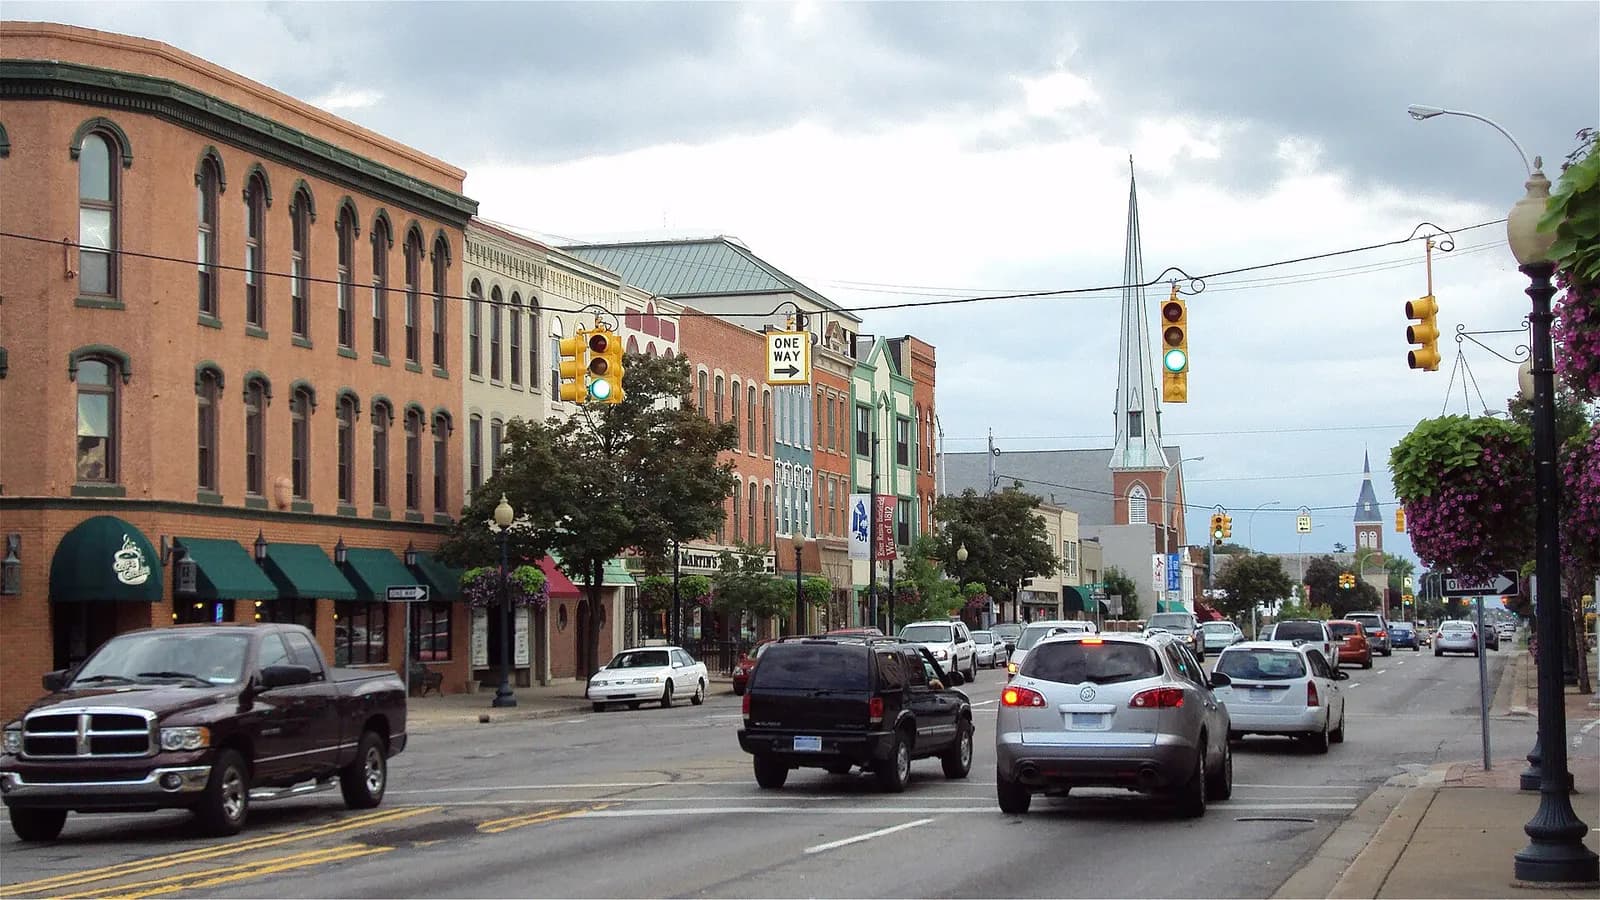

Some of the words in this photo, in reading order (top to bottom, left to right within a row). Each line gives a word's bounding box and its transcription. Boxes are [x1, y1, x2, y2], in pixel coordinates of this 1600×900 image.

[774, 337, 799, 349] ONE
[773, 350, 800, 362] WAY
[884, 506, 893, 522] 1812
[884, 524, 892, 534] of
[885, 537, 895, 556] War
[1449, 580, 1471, 590] ON
